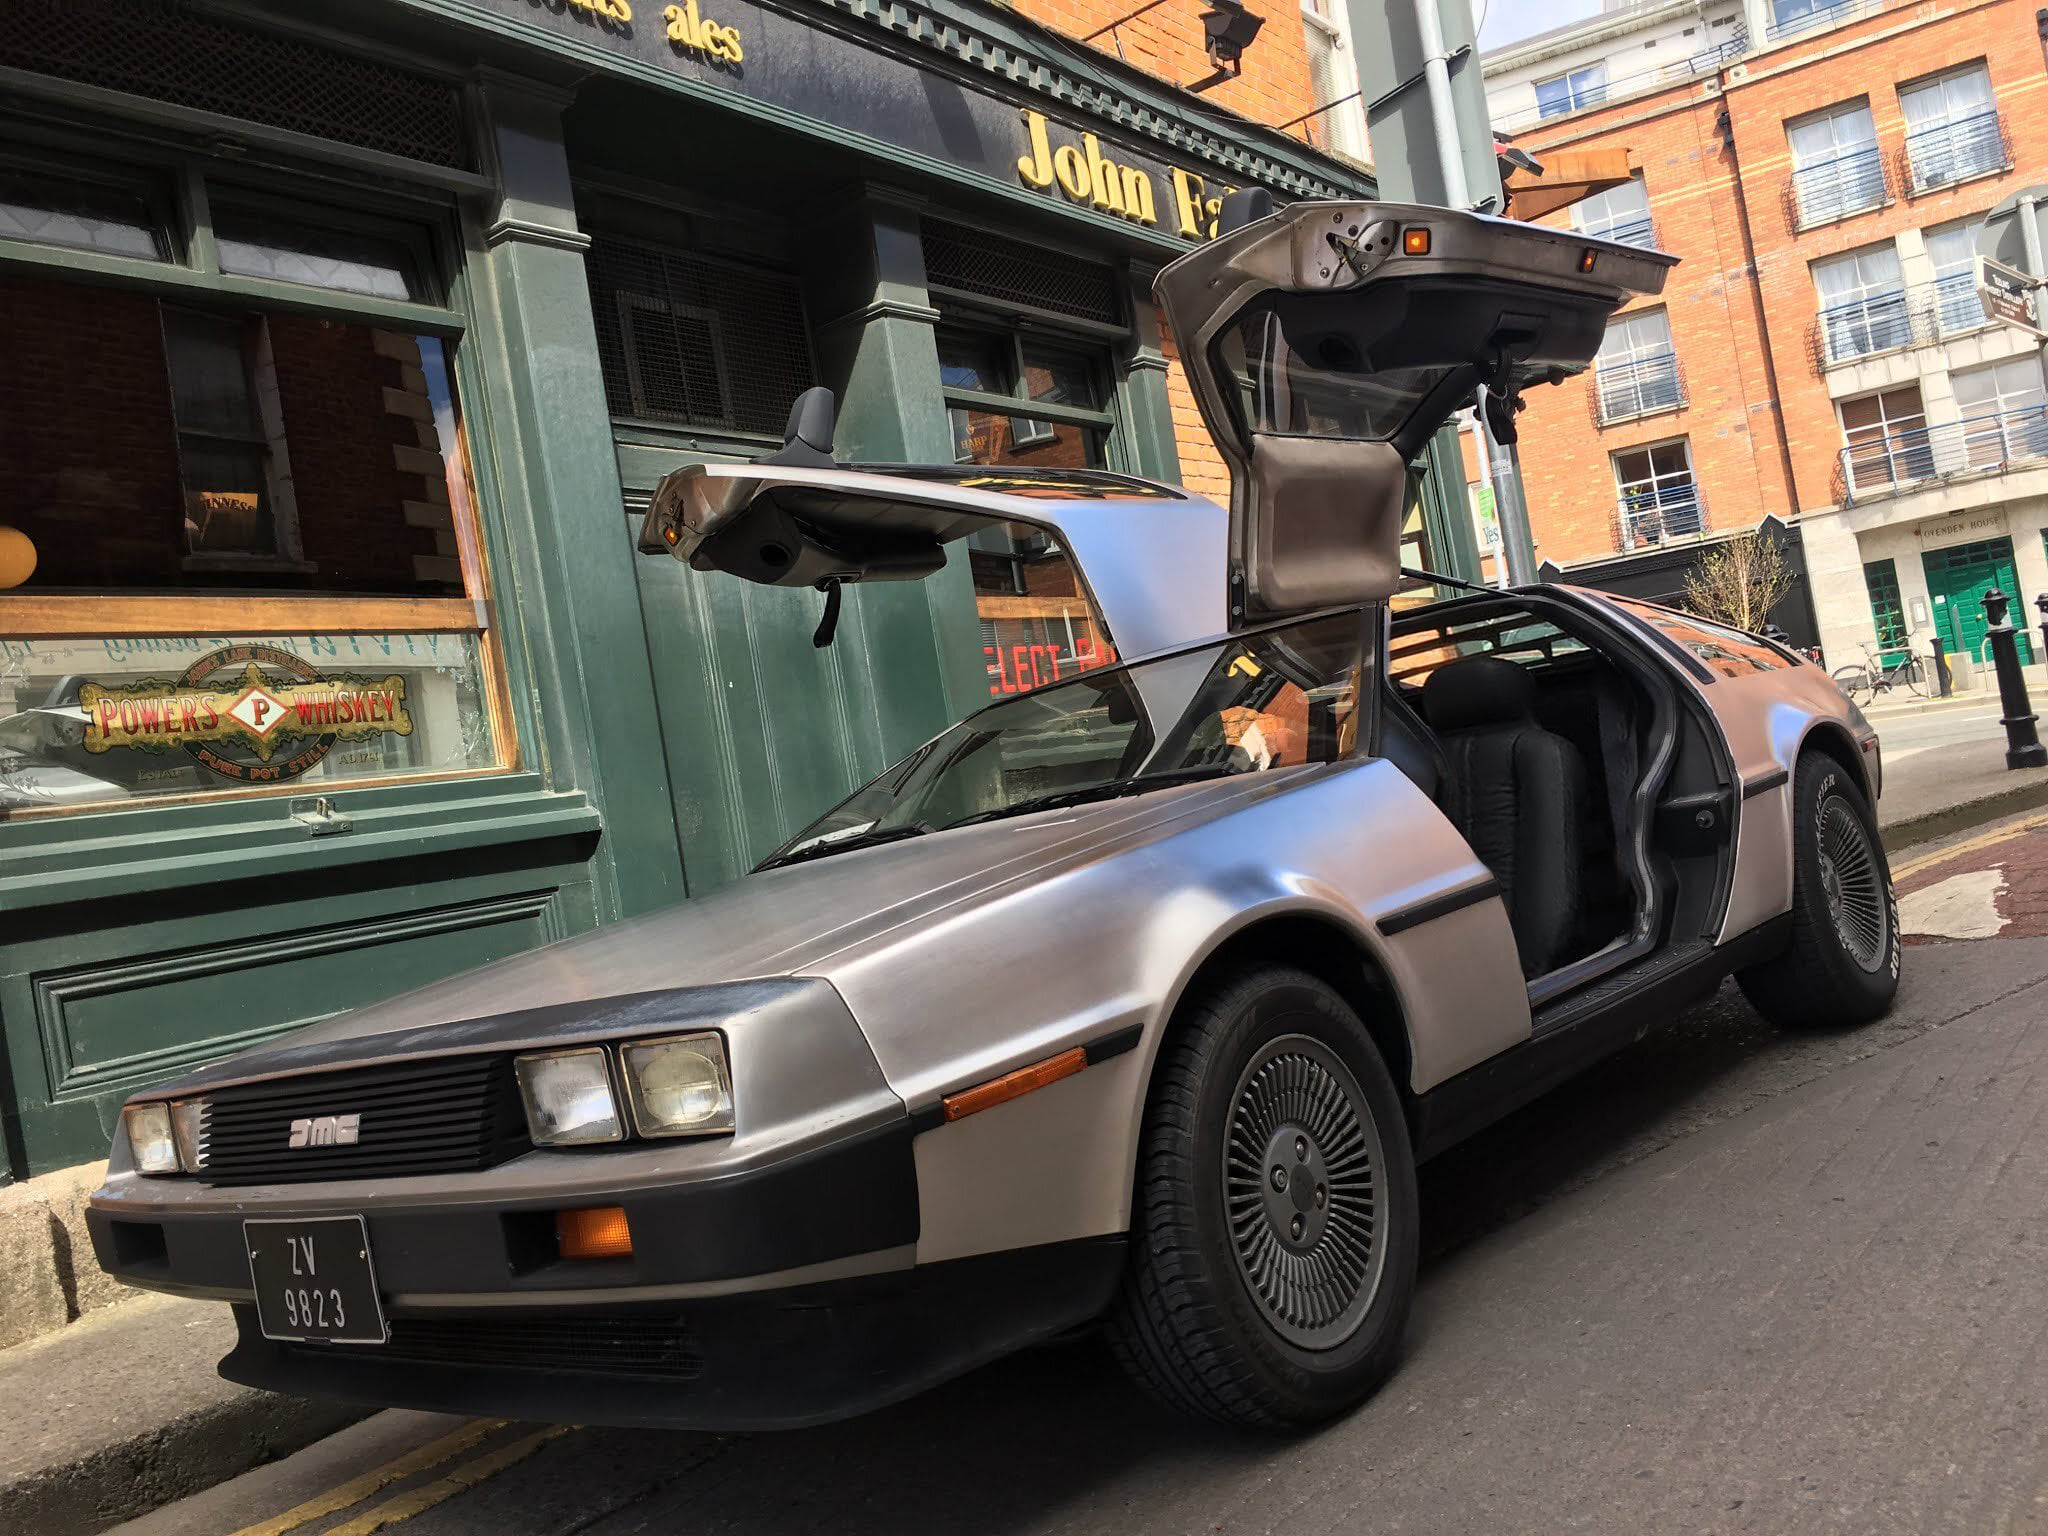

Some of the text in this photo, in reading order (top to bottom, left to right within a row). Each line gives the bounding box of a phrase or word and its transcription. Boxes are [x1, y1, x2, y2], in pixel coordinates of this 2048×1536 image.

[664, 0, 744, 63] ales
[1018, 108, 1157, 224] John
[961, 435, 988, 449] HARP
[1482, 526, 1500, 545] Yes
[1970, 516, 2000, 529] HOUSE
[223, 647, 254, 663] LANE
[98, 692, 219, 739] POWER'S
[251, 698, 271, 726] P
[293, 690, 395, 726] WHISKEY
[198, 749, 243, 778] PURE
[250, 766, 281, 780] POT
[288, 743, 329, 773] STILL
[1886, 881, 1900, 980] DUNLOP
[287, 1236, 316, 1276] ZV
[285, 1288, 346, 1328] 9823
